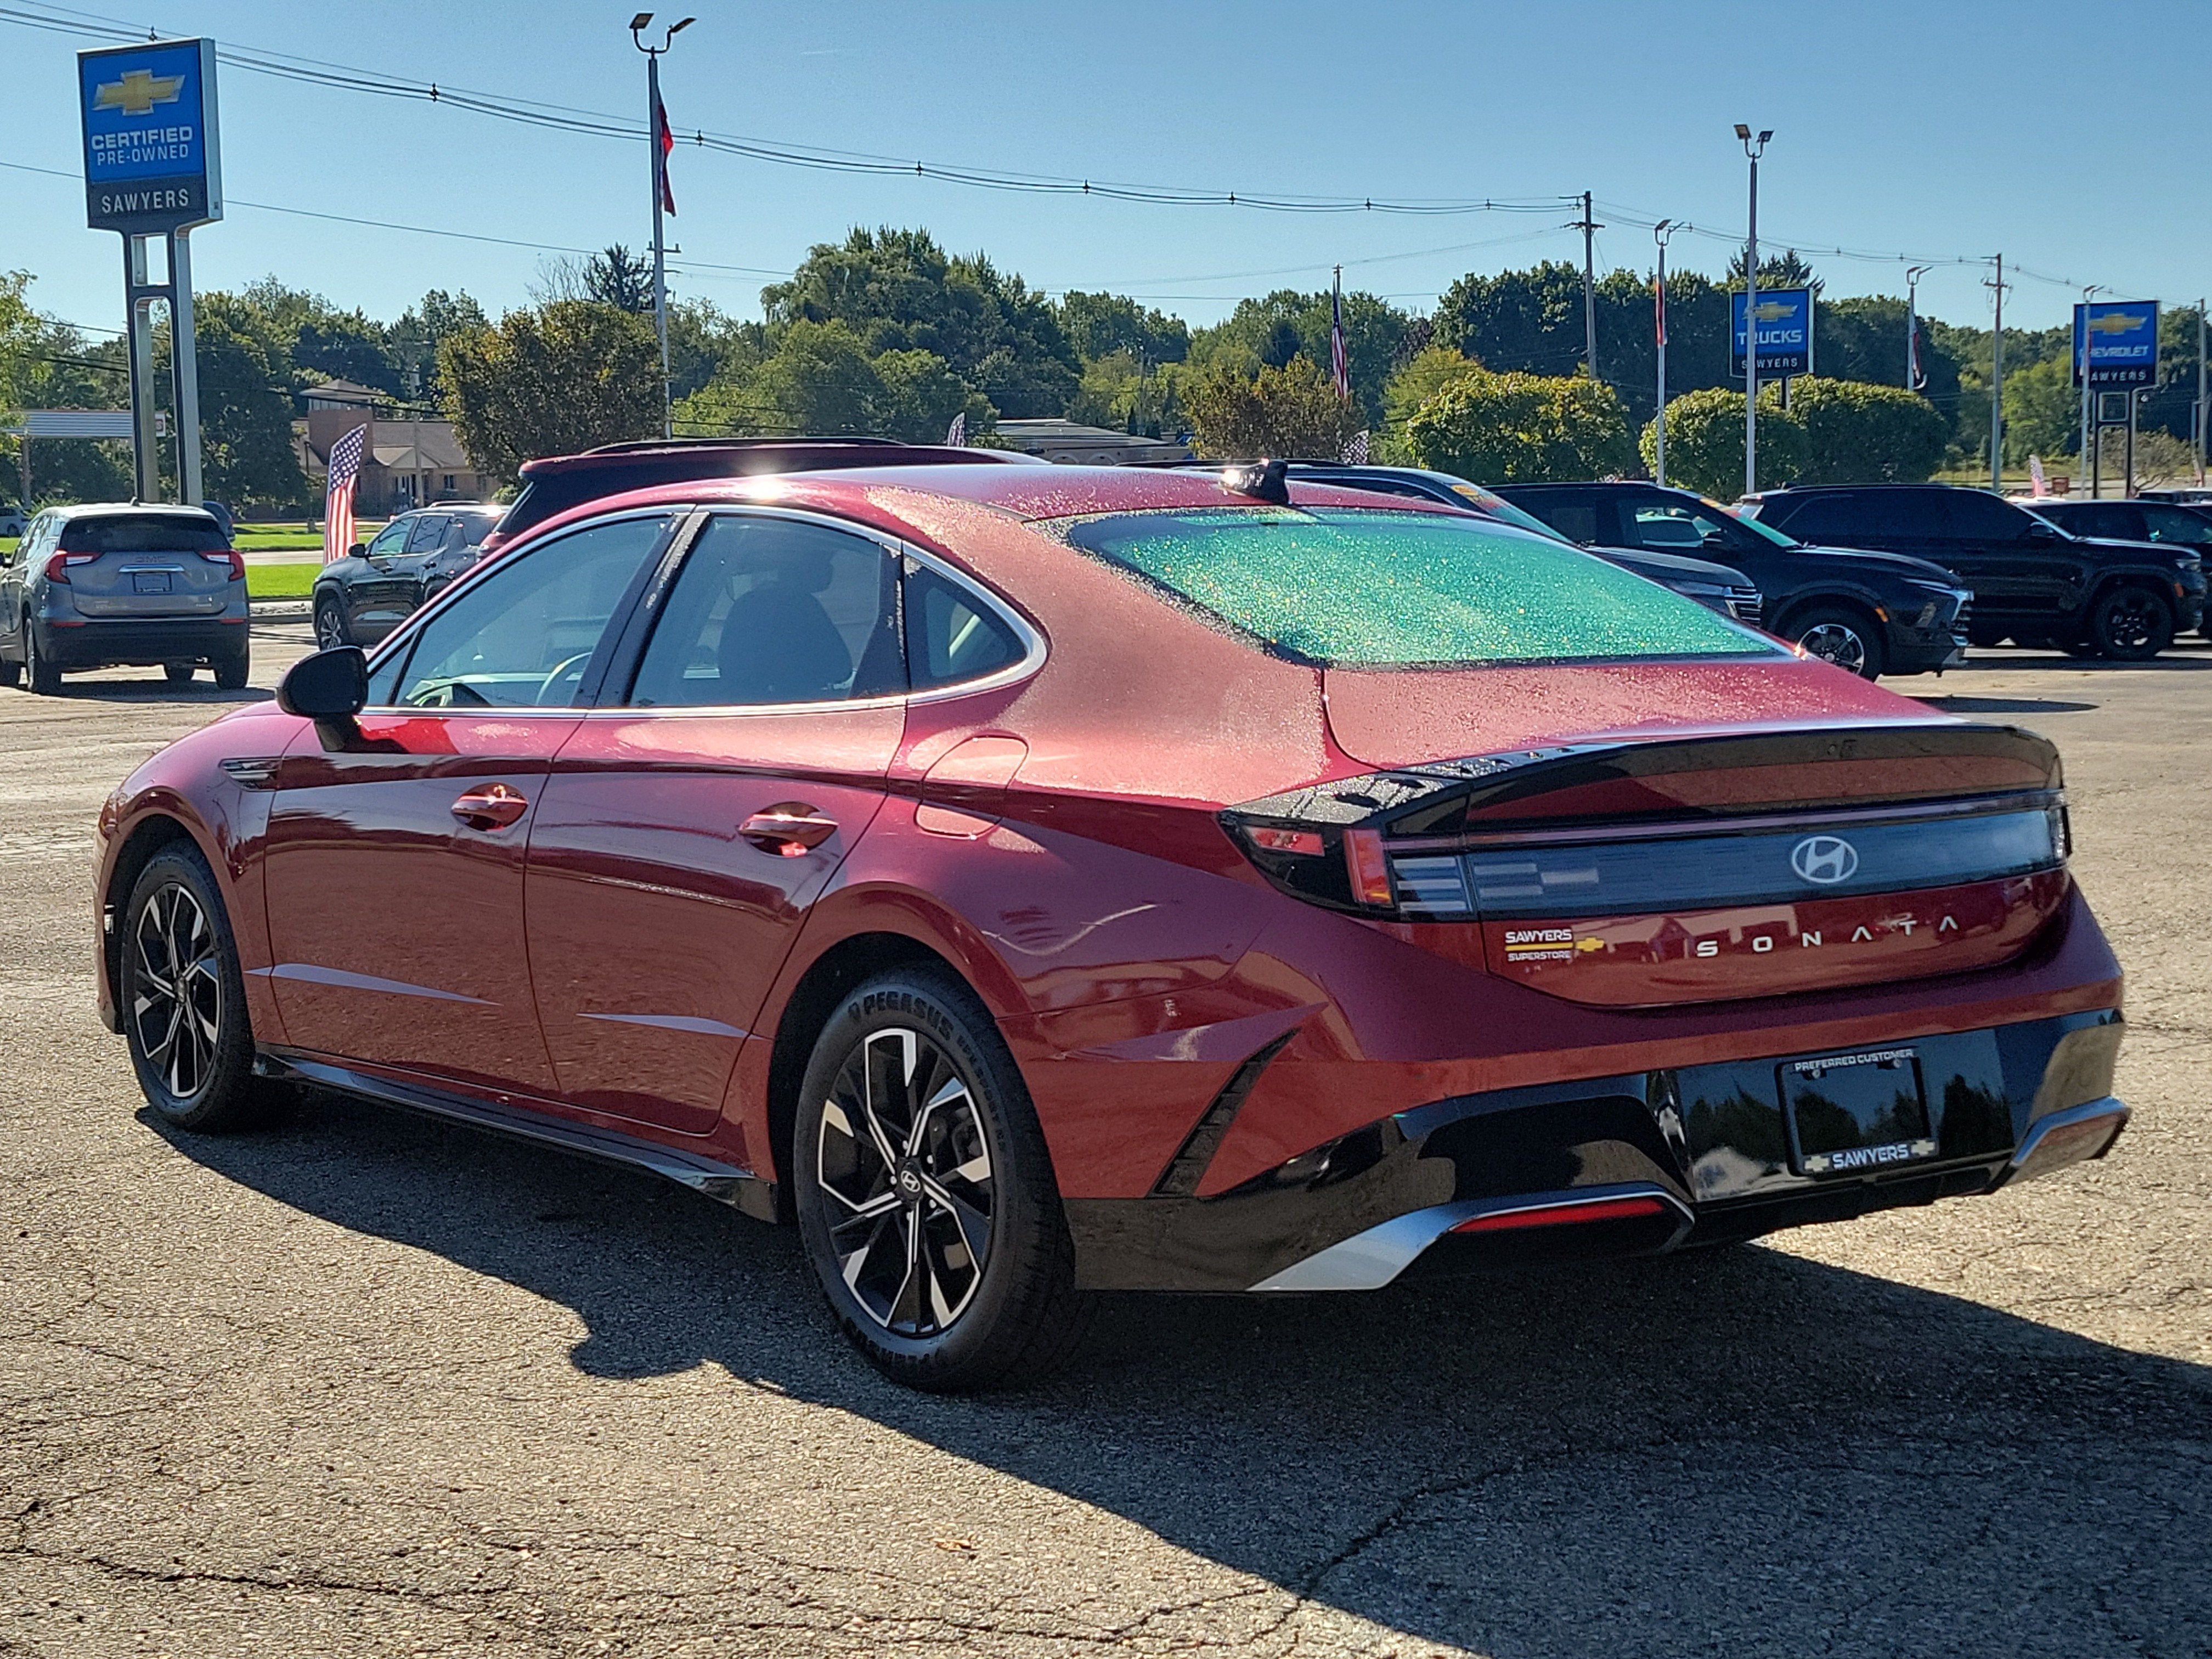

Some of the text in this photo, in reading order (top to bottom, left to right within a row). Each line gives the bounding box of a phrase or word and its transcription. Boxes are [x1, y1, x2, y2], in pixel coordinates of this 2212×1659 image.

[91, 126, 193, 150] CERTIFIED
[97, 143, 189, 166] PRE-OWNED
[101, 188, 189, 214] SAWYERS
[1736, 329, 1802, 346] TUCKS
[2078, 345, 2149, 358] EVROLET
[1741, 357, 1798, 370] SWYERS
[2091, 369, 2147, 382] AWYERS
[1505, 929, 1572, 944] SAWYERS
[1696, 915, 1959, 957] SONATA
[1508, 950, 1571, 962] SUPERSTORE
[1795, 1048, 1914, 1071] PREFERRED CUSTOMER
[1832, 1143, 1909, 1170] SAWYERS
